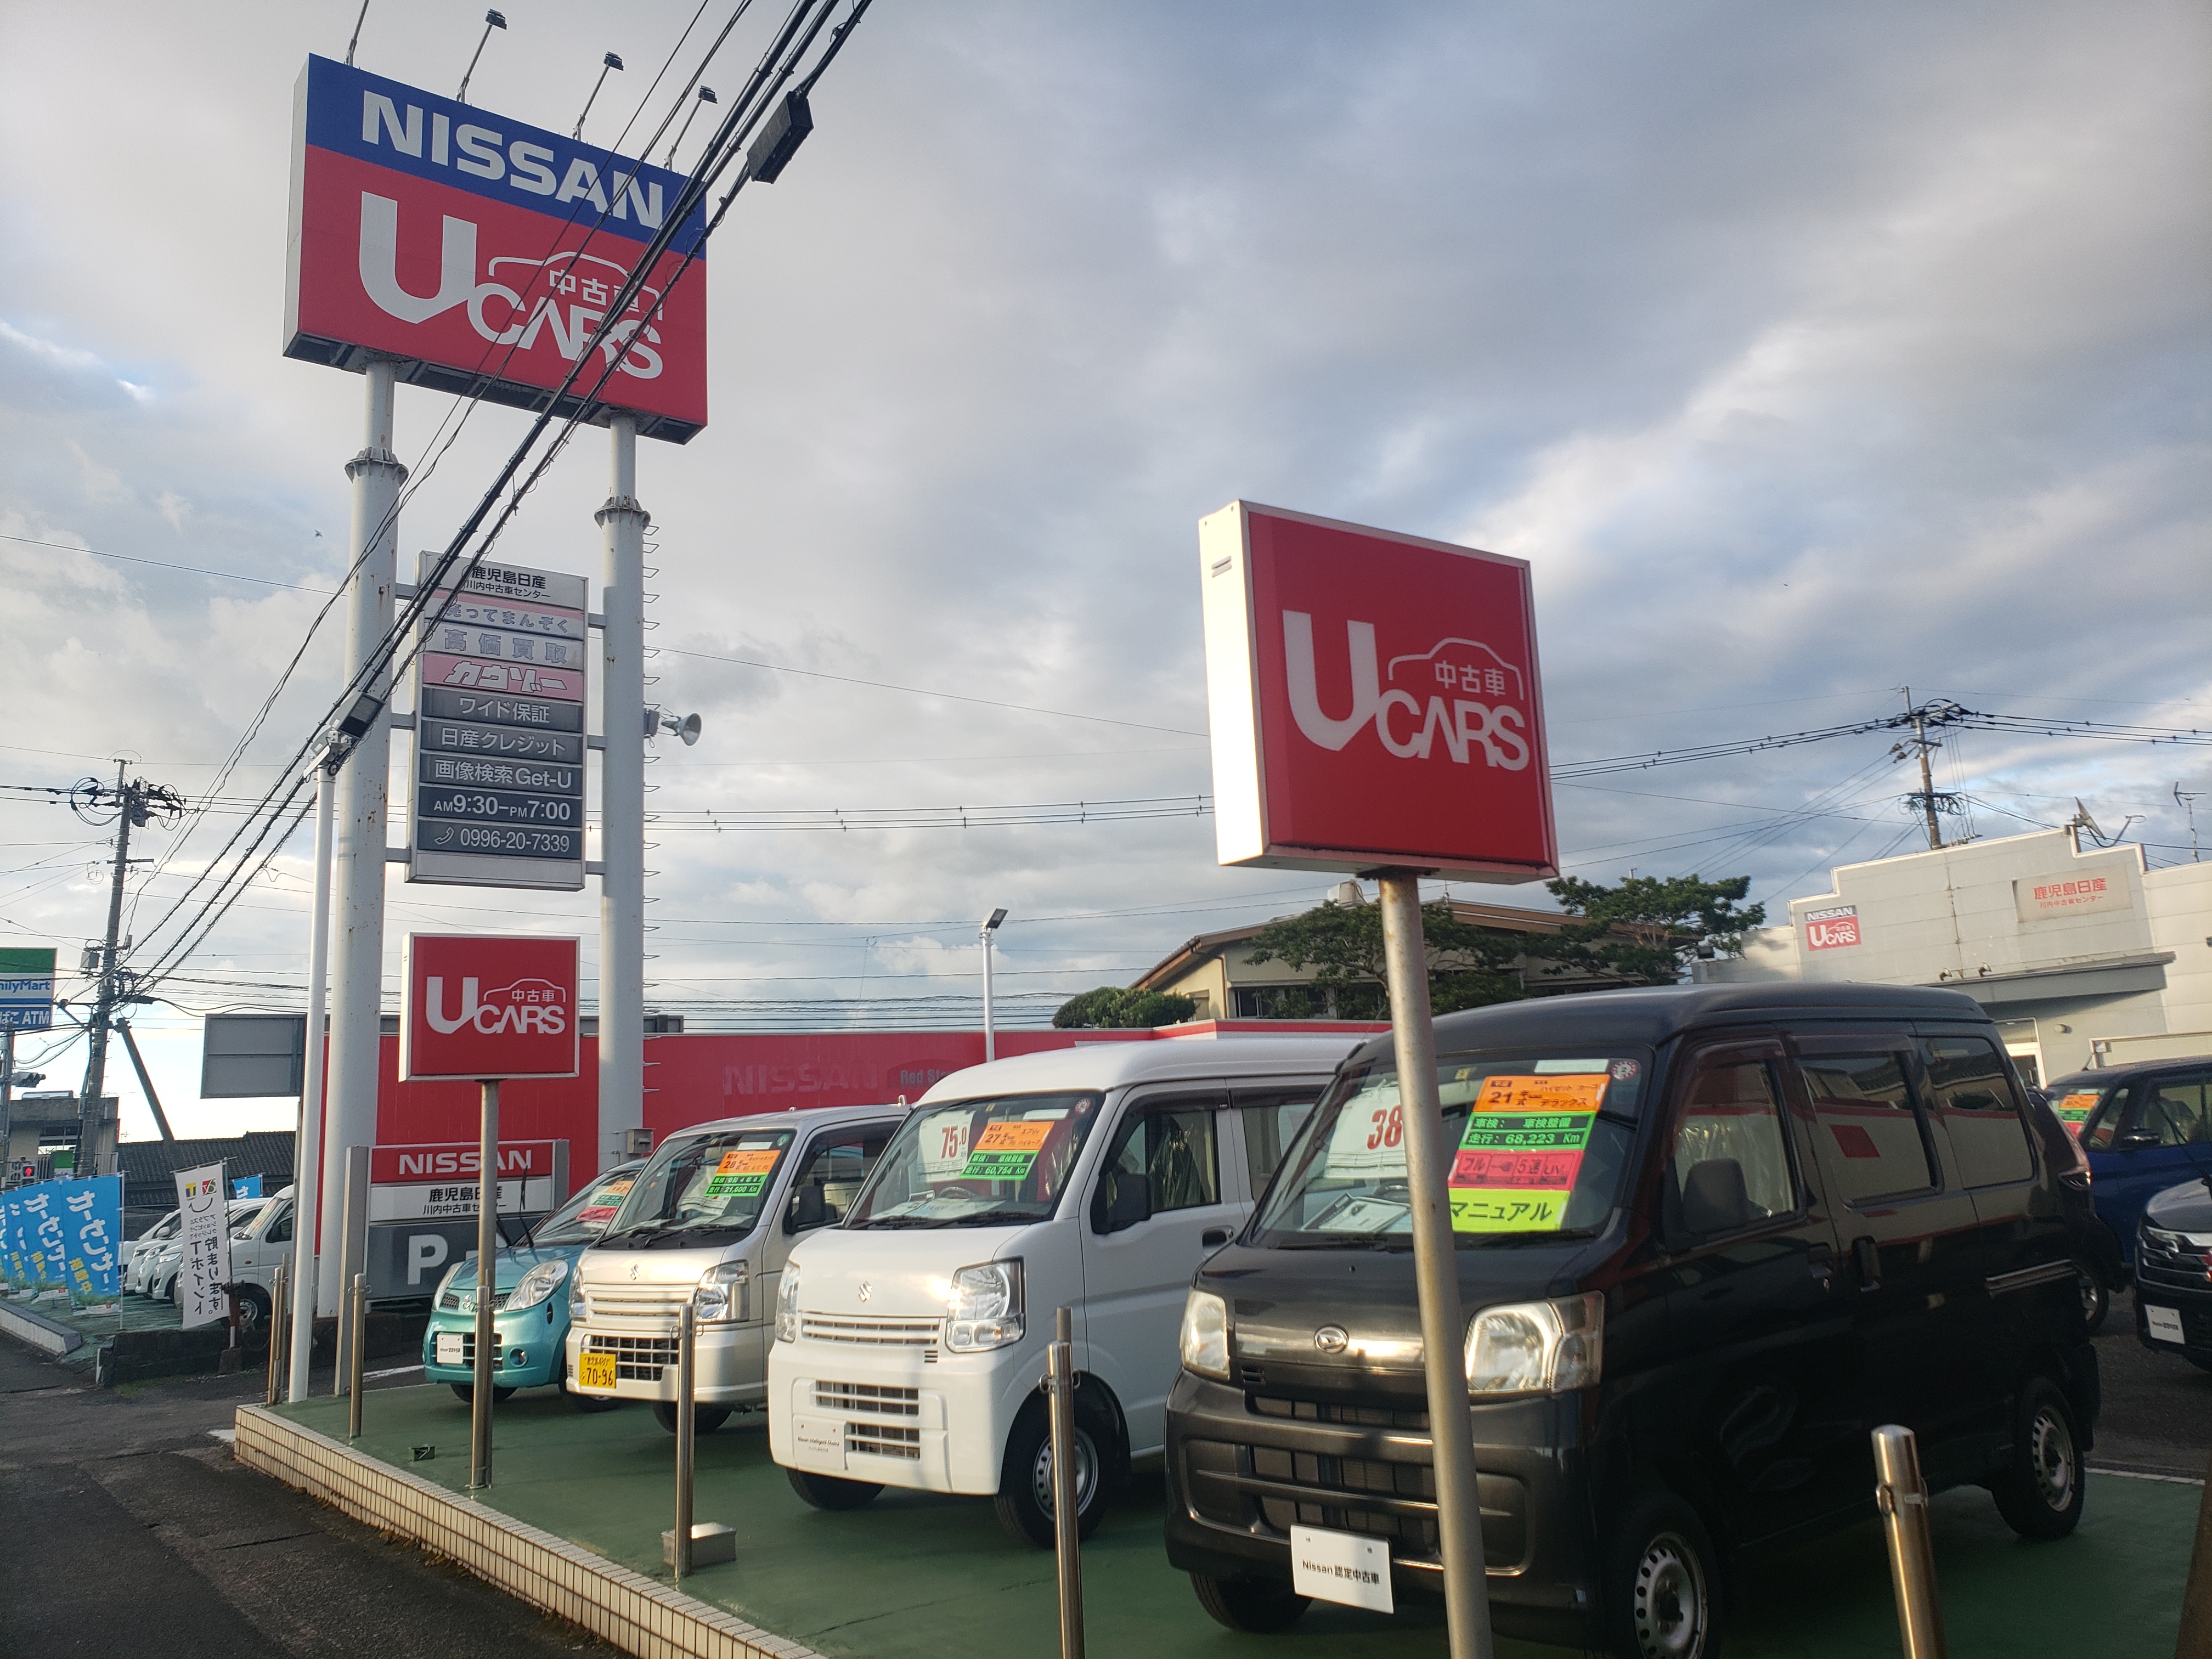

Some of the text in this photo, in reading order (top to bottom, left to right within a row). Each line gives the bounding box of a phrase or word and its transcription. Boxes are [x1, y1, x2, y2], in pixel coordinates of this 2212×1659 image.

[362, 89, 663, 230] NISSAN
[466, 580, 551, 599] 川内中古車センター
[472, 566, 546, 590] 鹿児島日産
[446, 604, 568, 633] 売ってまんぞく
[444, 629, 567, 664] 高価買取
[1434, 660, 1506, 696] 中古車
[459, 697, 550, 724] ワイド保証
[441, 727, 566, 755] 日産クレジット
[460, 828, 570, 853] 0996-20-7339
[2033, 878, 2107, 900] 鹿児島日産
[1807, 906, 1853, 921] NISSAN
[2039, 895, 2104, 909] 川内中古車センター
[511, 989, 555, 1002] 中古車
[22, 1011, 49, 1024] ATM
[723, 1060, 878, 1096] NISSAN
[900, 1069, 923, 1084] Red
[1488, 1091, 1513, 1103] 21
[985, 1133, 1001, 1143] 27
[1367, 1104, 1403, 1150] 38
[1505, 1133, 1555, 1145] 68,223
[1563, 1133, 1580, 1143] Km
[941, 1125, 967, 1159] 75.0
[985, 1166, 1013, 1175] 60,754
[423, 1203, 507, 1215] 川内中古車セー
[1450, 1201, 1553, 1221] マニュアル
[66, 1190, 114, 1284] カーセンサー
[407, 1234, 448, 1285] P
[1302, 1559, 1380, 1585] Nissan 認定中古車
